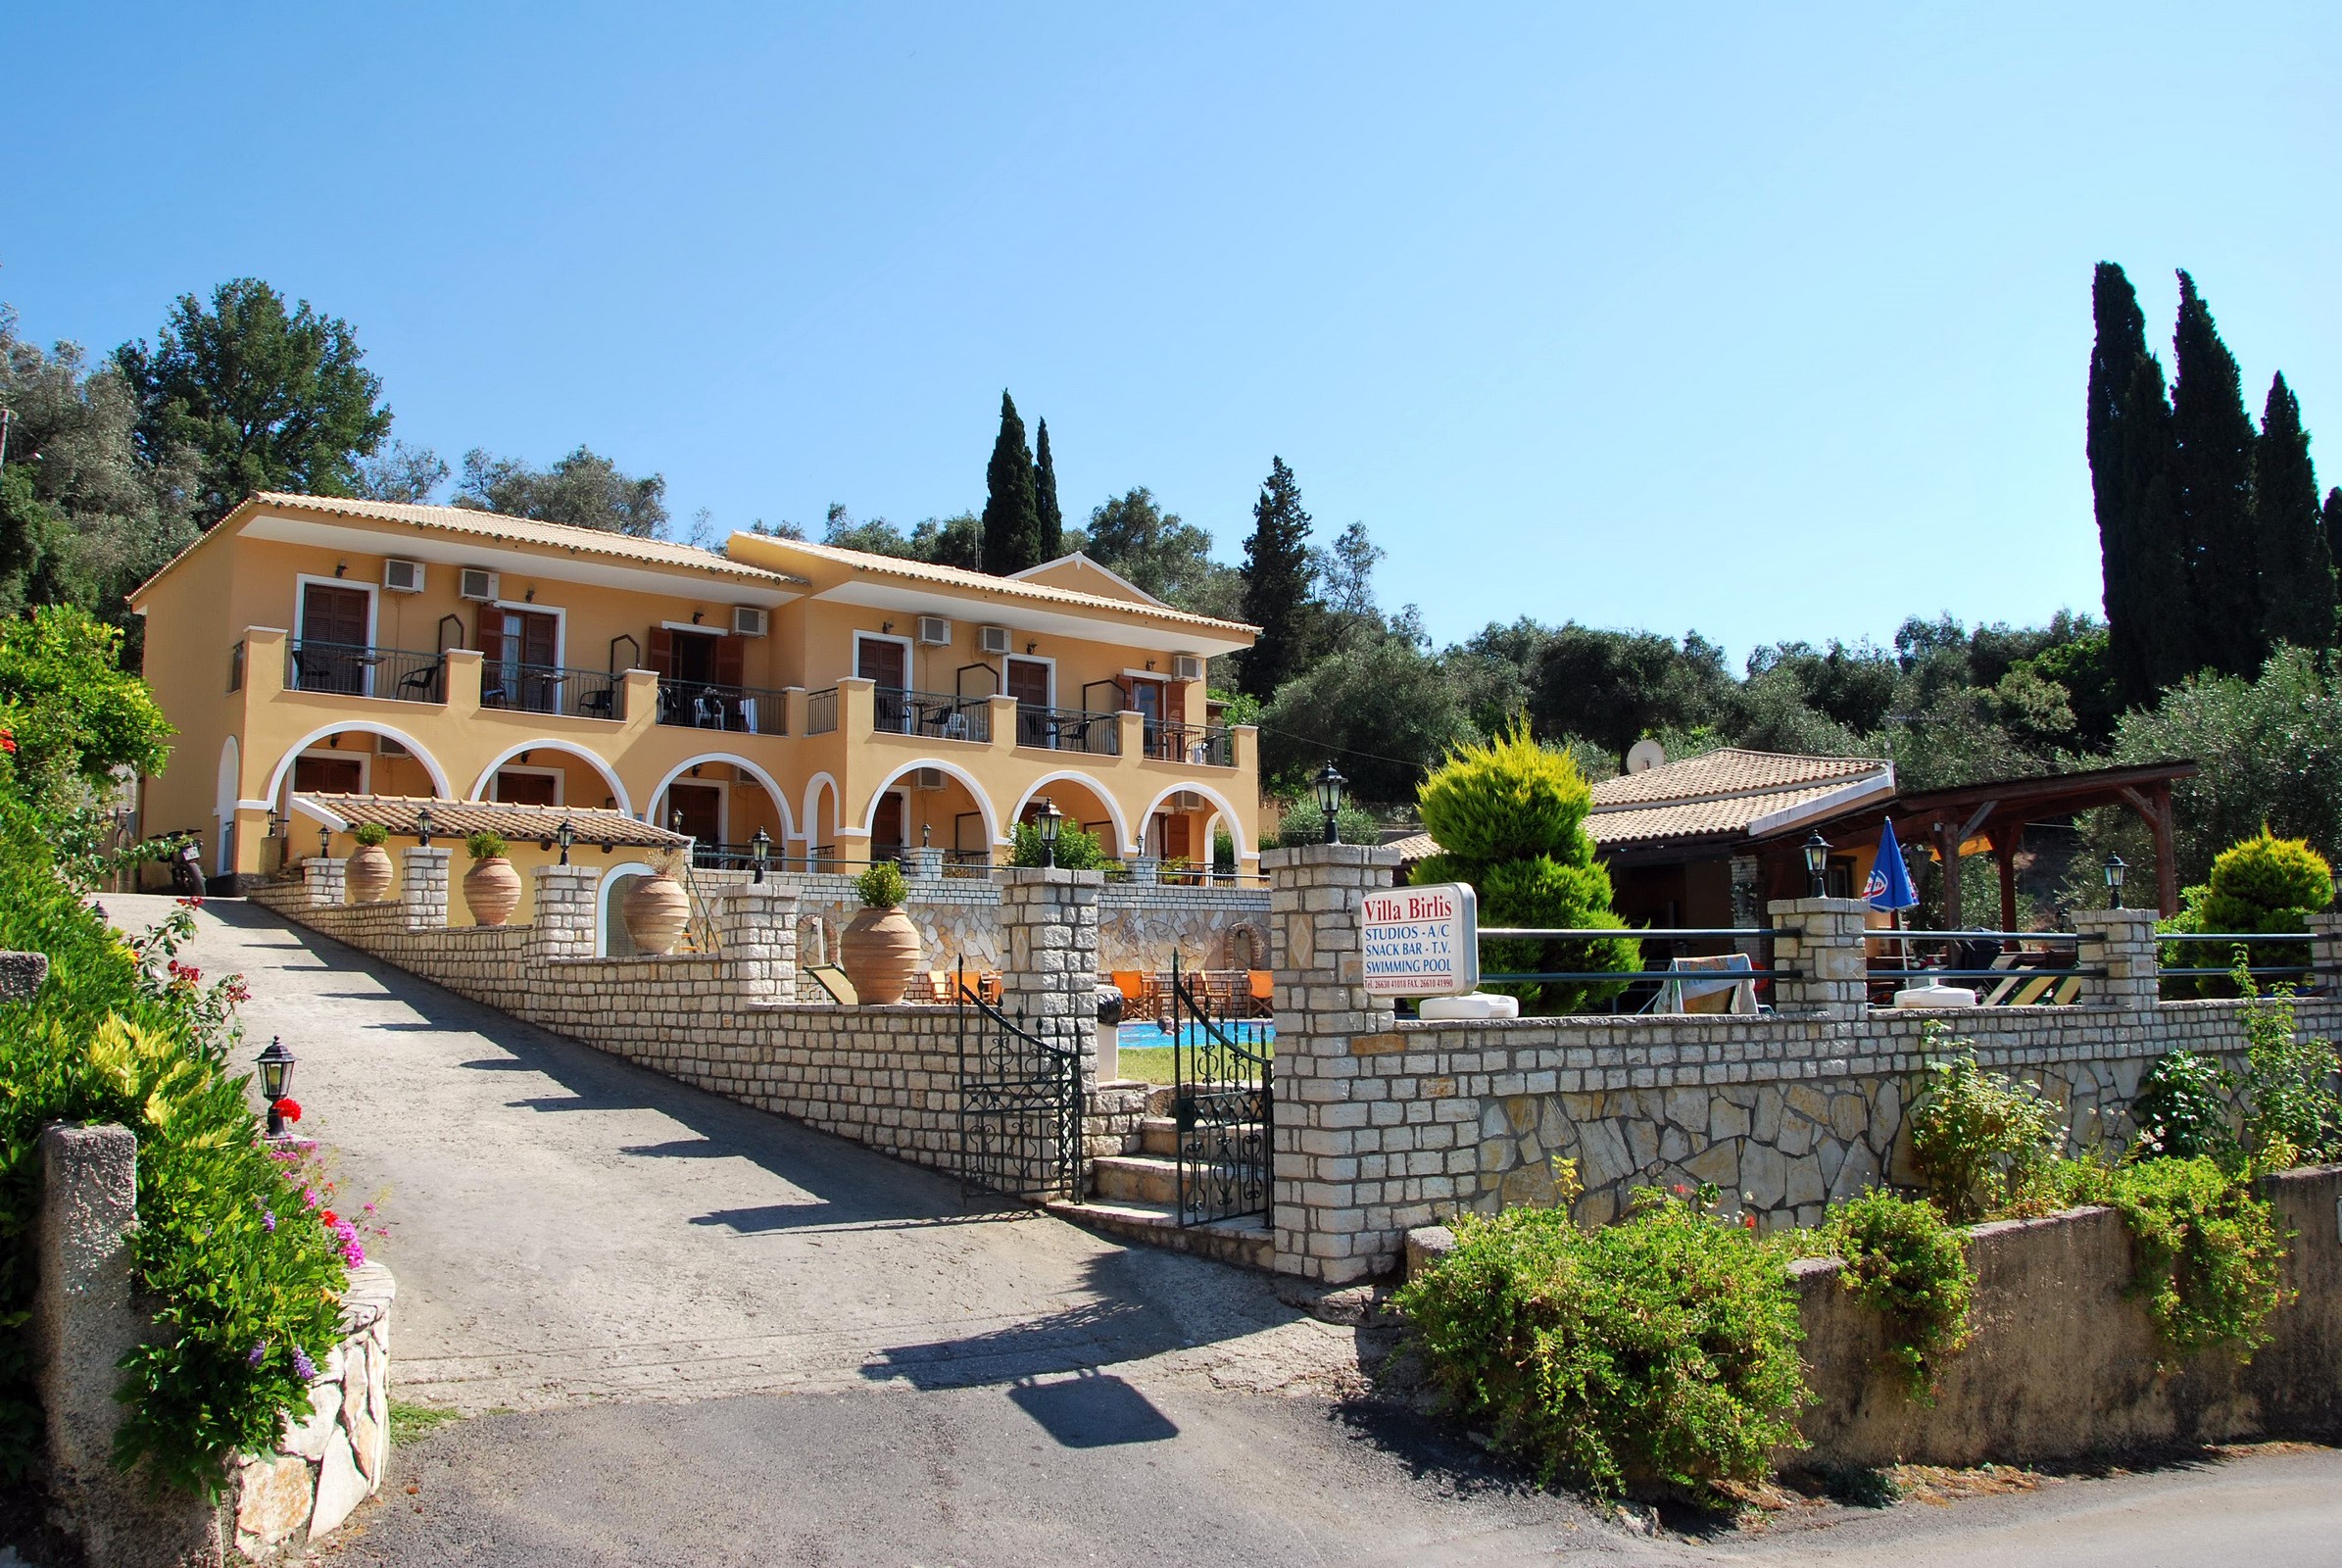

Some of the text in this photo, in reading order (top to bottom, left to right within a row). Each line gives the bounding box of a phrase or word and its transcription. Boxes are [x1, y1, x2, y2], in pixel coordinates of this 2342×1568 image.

[1364, 895, 1452, 921] Villa Birlis
[1365, 926, 1418, 941] STUDIOS
[1427, 924, 1450, 939] A/C
[1366, 943, 1399, 957] SNACK
[1402, 942, 1422, 955] BAR
[1432, 941, 1451, 954] T.V.
[1366, 958, 1452, 973] SWIMMING POOL
